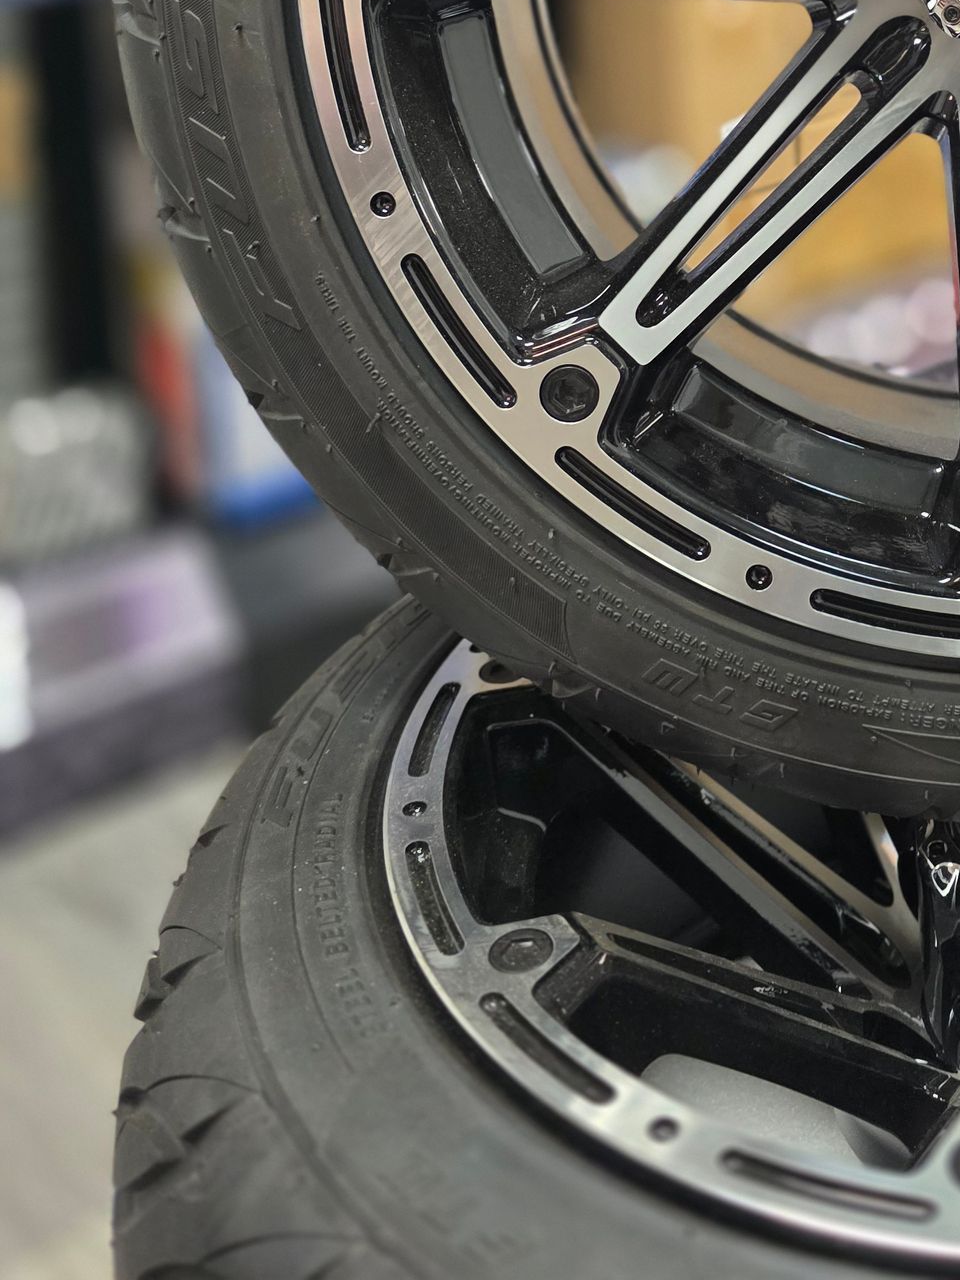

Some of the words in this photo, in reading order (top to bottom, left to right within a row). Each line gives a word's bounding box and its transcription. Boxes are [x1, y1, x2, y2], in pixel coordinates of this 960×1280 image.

[354, 346, 387, 389] MOUNT
[385, 390, 425, 438] SHOULD
[425, 440, 473, 492] PERSONS
[474, 491, 525, 539] TRAINED
[511, 542, 571, 591] IMPROPER
[640, 658, 798, 734] GTW
[753, 675, 788, 697] TIRE
[782, 670, 841, 698] INFLATE
[870, 693, 936, 715] ATTEMPT
[815, 694, 893, 723] EXPLOSION
